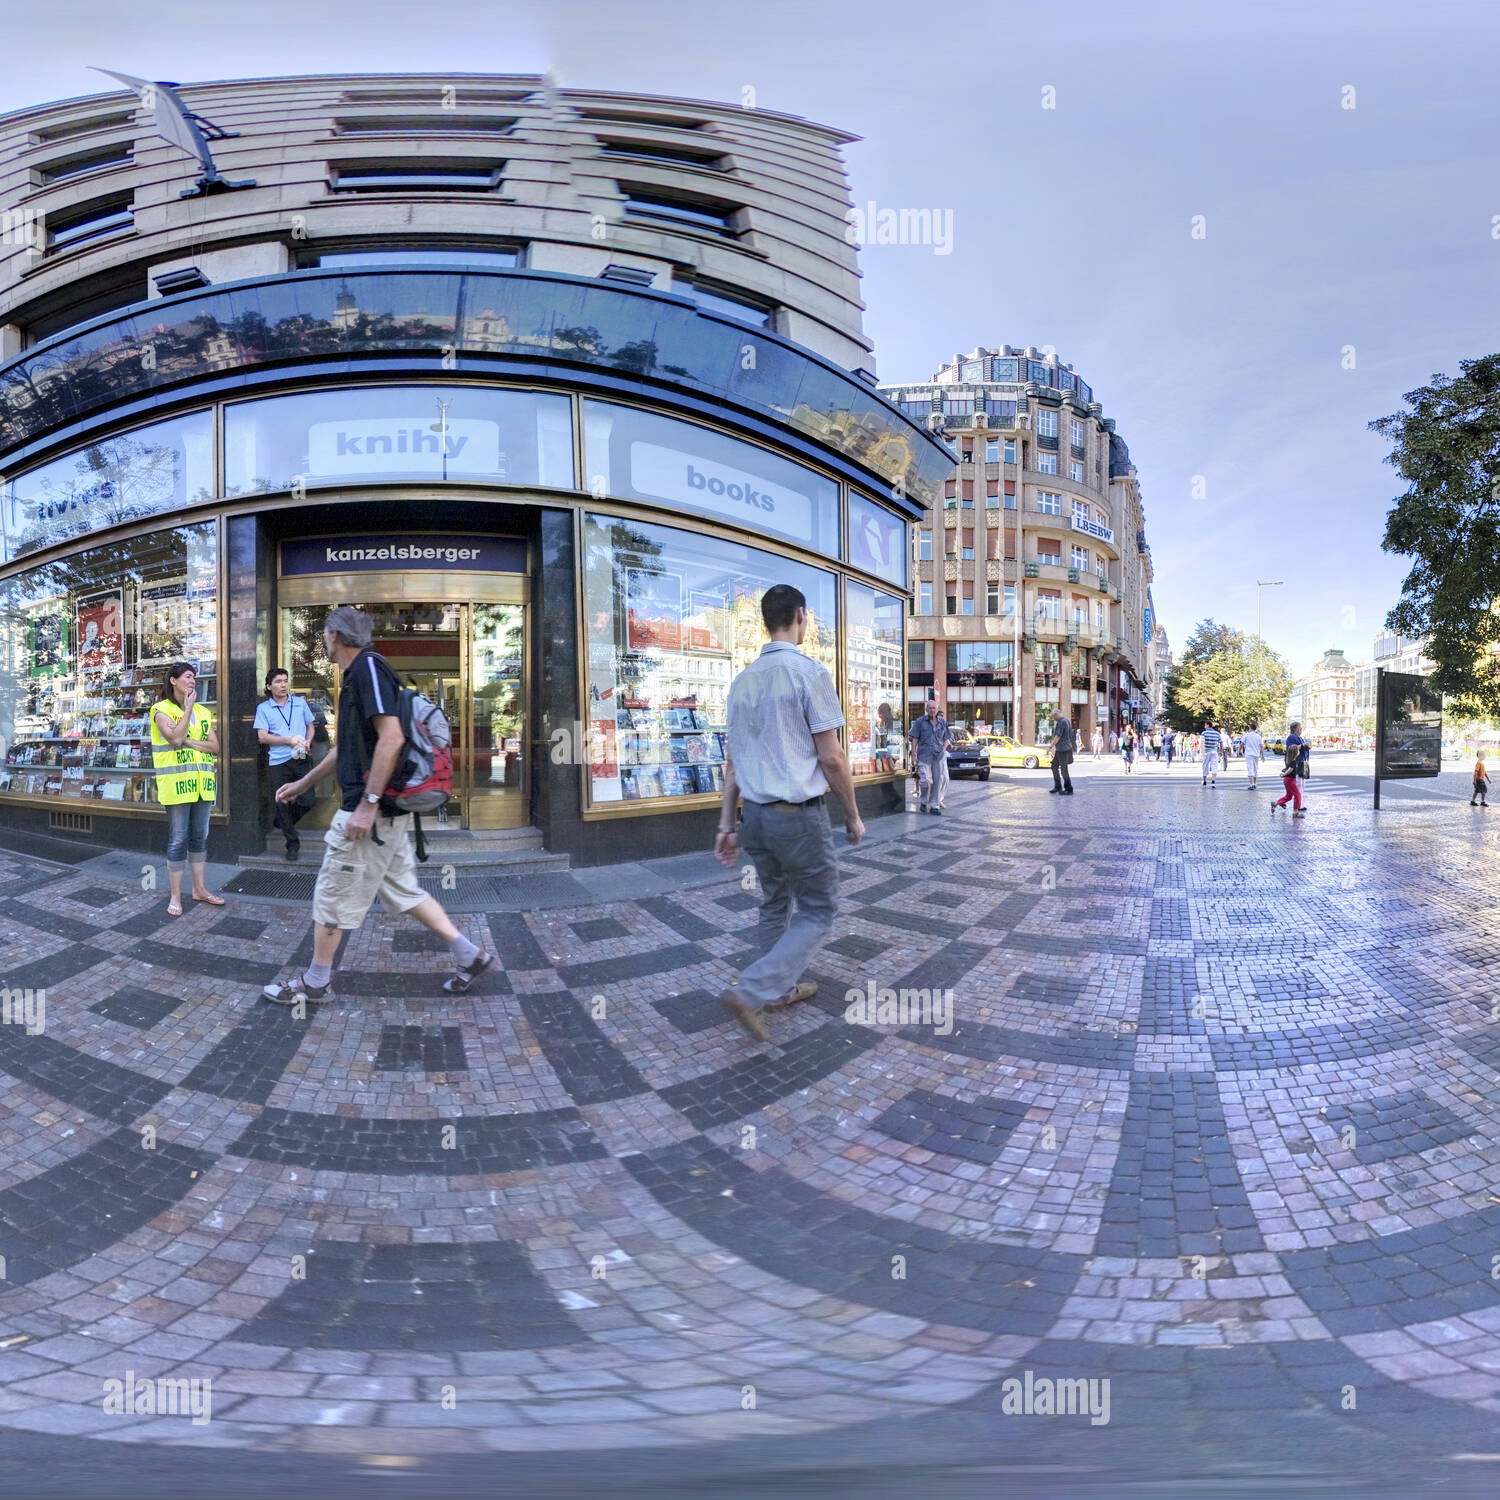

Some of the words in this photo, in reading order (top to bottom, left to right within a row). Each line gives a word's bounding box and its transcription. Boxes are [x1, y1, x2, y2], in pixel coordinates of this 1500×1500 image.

[336, 429, 469, 459] knihy
[687, 464, 776, 513] books
[326, 545, 481, 562] kanzelsberger
[176, 779, 198, 795] IRISH
